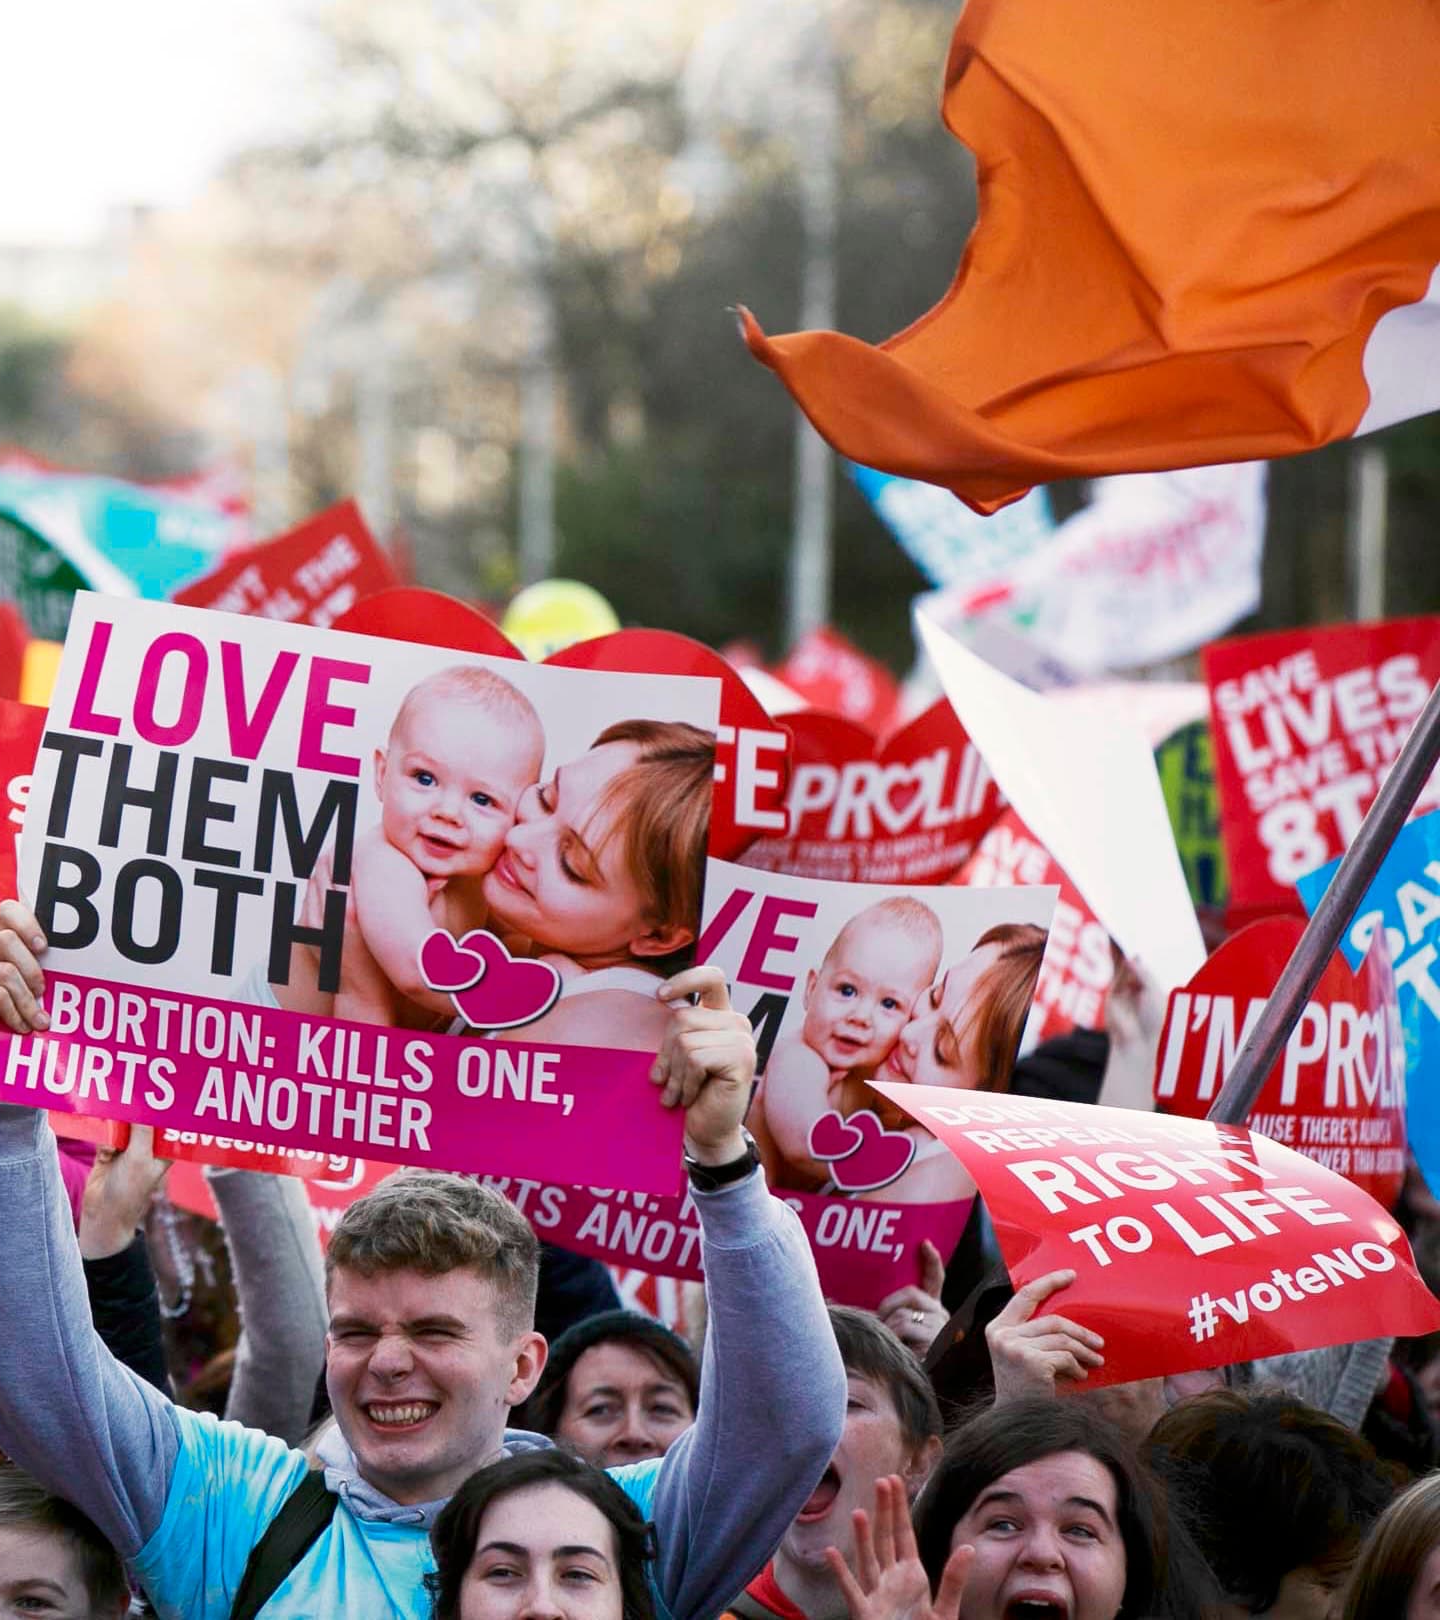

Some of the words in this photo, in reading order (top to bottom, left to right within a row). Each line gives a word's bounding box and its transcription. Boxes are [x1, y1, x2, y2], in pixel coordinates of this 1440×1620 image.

[69, 621, 372, 777] LOVE
[1214, 648, 1320, 713] SAVE
[1226, 654, 1432, 777] LIVES
[41, 731, 359, 887] THEM
[1244, 741, 1349, 813] SAVE
[32, 842, 348, 994] BOTH
[3, 1034, 178, 1112] HURTS
[194, 1066, 434, 1151] ANOTHER
[49, 981, 277, 1068] BORTION:
[297, 1023, 435, 1094] KILLS
[456, 1051, 576, 1118] ONE,
[962, 1126, 1155, 1154] REPEAL
[1006, 1149, 1280, 1216] RIGHT
[815, 1202, 905, 1263] ONE,
[1067, 1215, 1154, 1269] TO
[1151, 1186, 1354, 1257] LIFE
[1186, 1241, 1398, 1344] #voteNO
